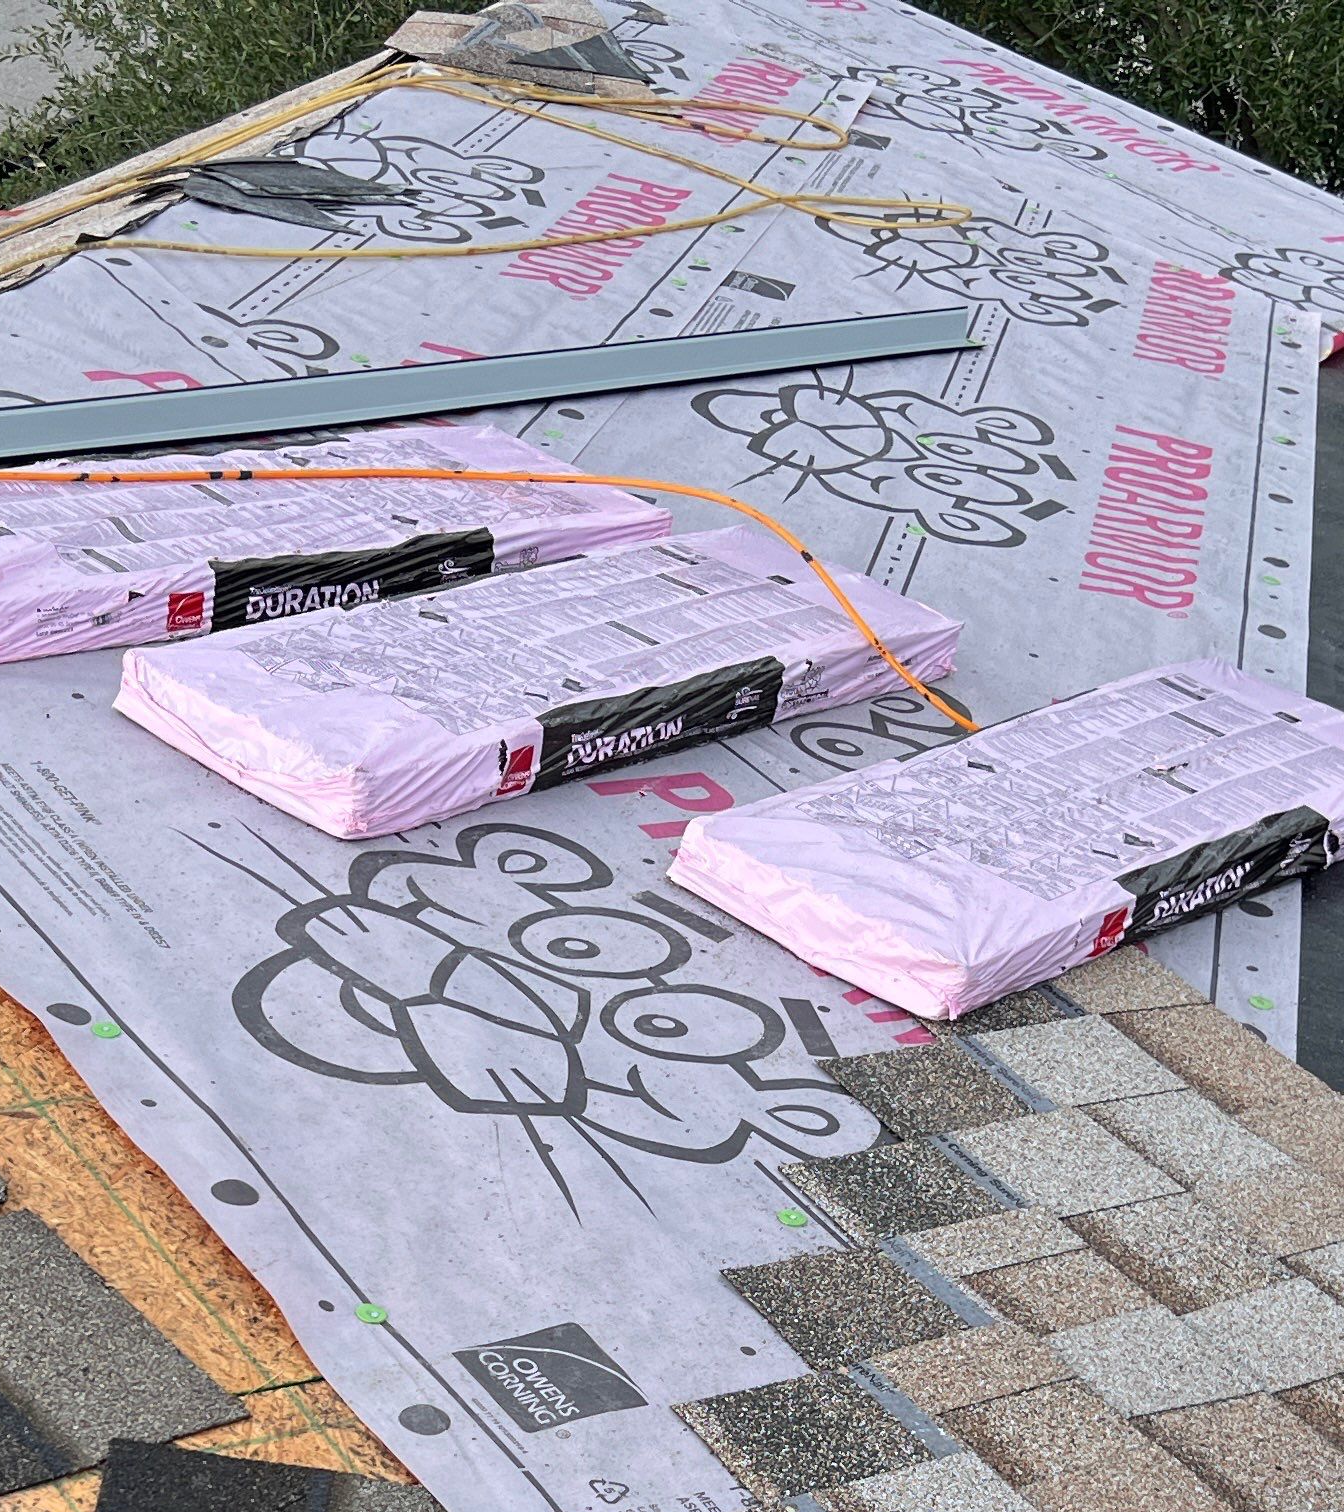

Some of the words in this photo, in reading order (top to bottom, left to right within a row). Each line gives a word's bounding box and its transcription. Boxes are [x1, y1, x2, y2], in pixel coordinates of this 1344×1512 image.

[1133, 261, 1236, 374] ROARMOR
[1078, 424, 1213, 609] PROARMOR
[245, 580, 380, 621] DURATION
[478, 1351, 557, 1425] CORNING
[512, 1357, 580, 1418] OWENS
